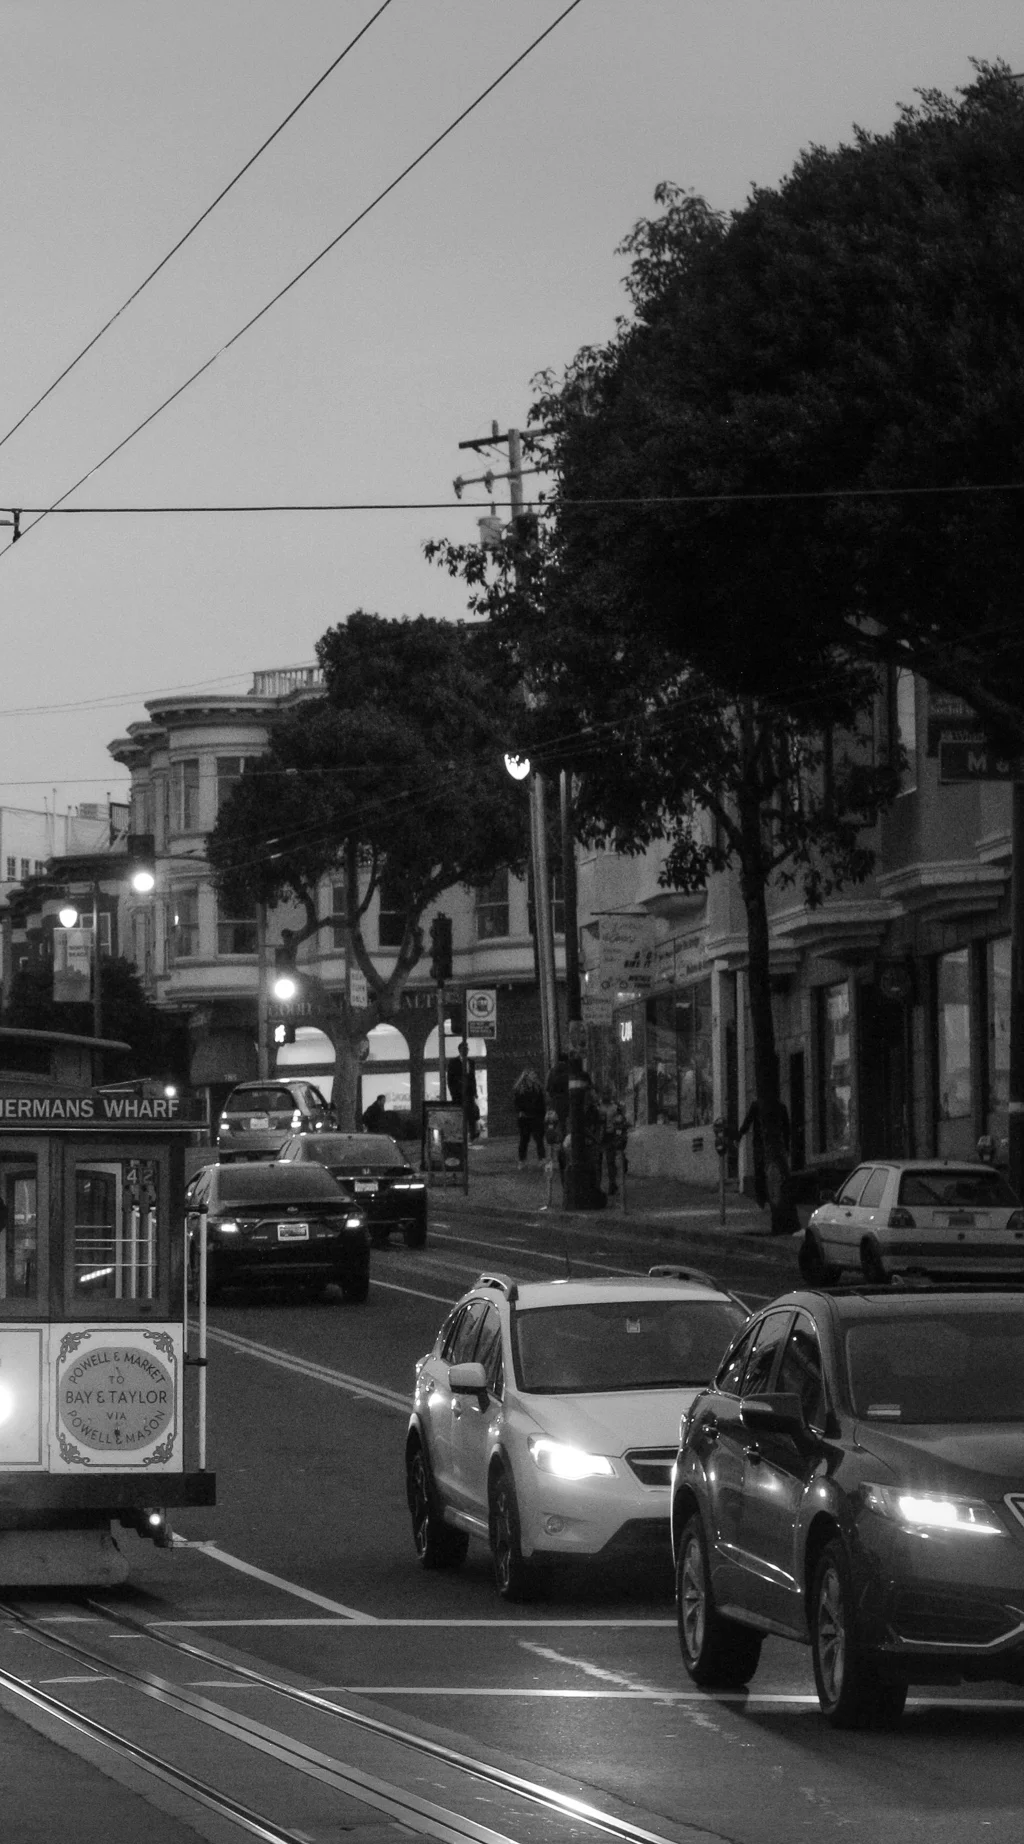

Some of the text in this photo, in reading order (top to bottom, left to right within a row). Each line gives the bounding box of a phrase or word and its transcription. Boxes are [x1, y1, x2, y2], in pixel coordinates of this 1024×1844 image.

[103, 1098, 180, 1117] WHARF
[68, 1352, 111, 1385] POWELL
[124, 1352, 166, 1384] MARKET
[108, 1375, 125, 1384] TO
[65, 1390, 168, 1404] BAY & TAYLOR
[106, 1412, 127, 1420] VIA
[67, 1410, 112, 1444] POWELL
[125, 1410, 166, 1443] MASON
